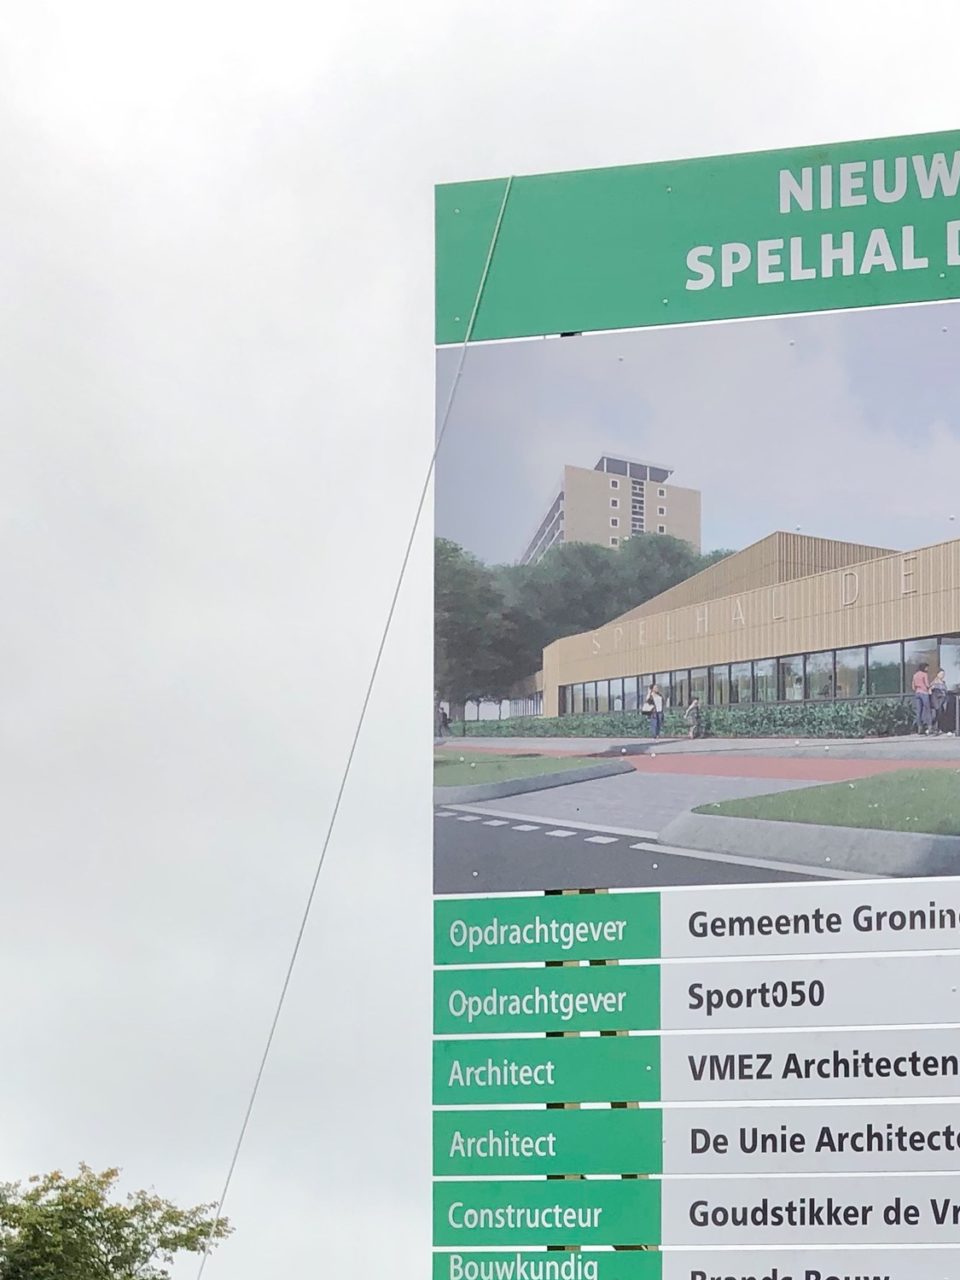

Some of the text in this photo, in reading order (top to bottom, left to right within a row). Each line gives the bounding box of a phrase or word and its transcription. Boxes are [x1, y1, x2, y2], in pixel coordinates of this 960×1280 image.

[685, 226, 929, 291] SPELHAL
[841, 555, 918, 607] DE
[449, 916, 627, 949] Opdrachtgever
[688, 908, 842, 938] Gemeente
[448, 987, 627, 1019] Opdrachtgever
[688, 979, 826, 1013] Sport050
[448, 1059, 555, 1086] Architect
[687, 1049, 960, 1081] VMEZ Architecten
[449, 1130, 557, 1158] Architect
[691, 1128, 728, 1154] De
[739, 1124, 806, 1154] Unie
[448, 1202, 603, 1229] Constructeur
[689, 1197, 873, 1227] Goudstikker
[883, 1197, 920, 1226] de
